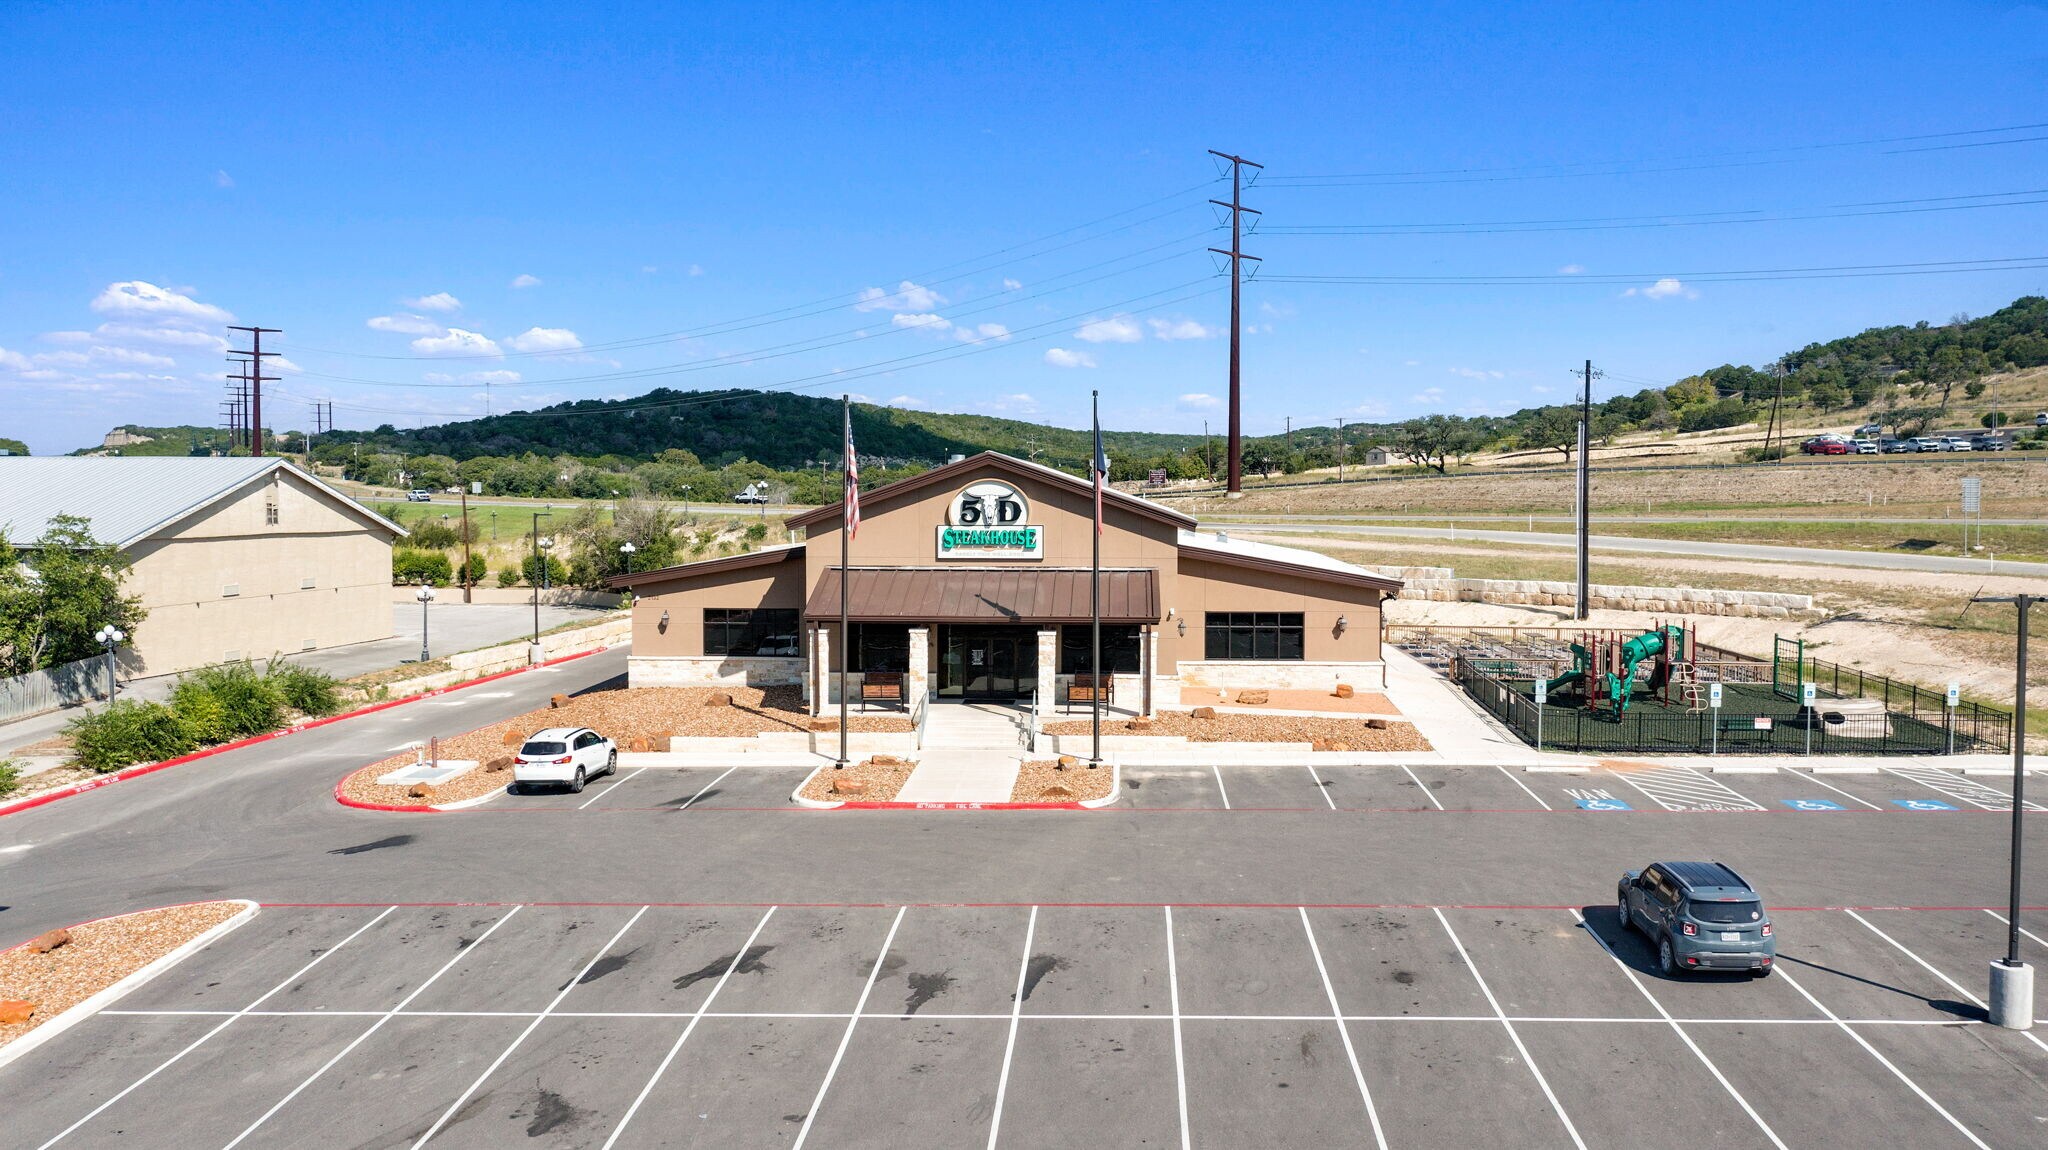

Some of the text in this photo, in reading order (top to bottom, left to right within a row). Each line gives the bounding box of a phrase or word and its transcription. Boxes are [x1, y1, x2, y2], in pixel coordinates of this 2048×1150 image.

[961, 500, 1022, 523] 5 D
[943, 528, 1037, 549] STEAKHOUSE
[1562, 789, 1616, 800] VAN
